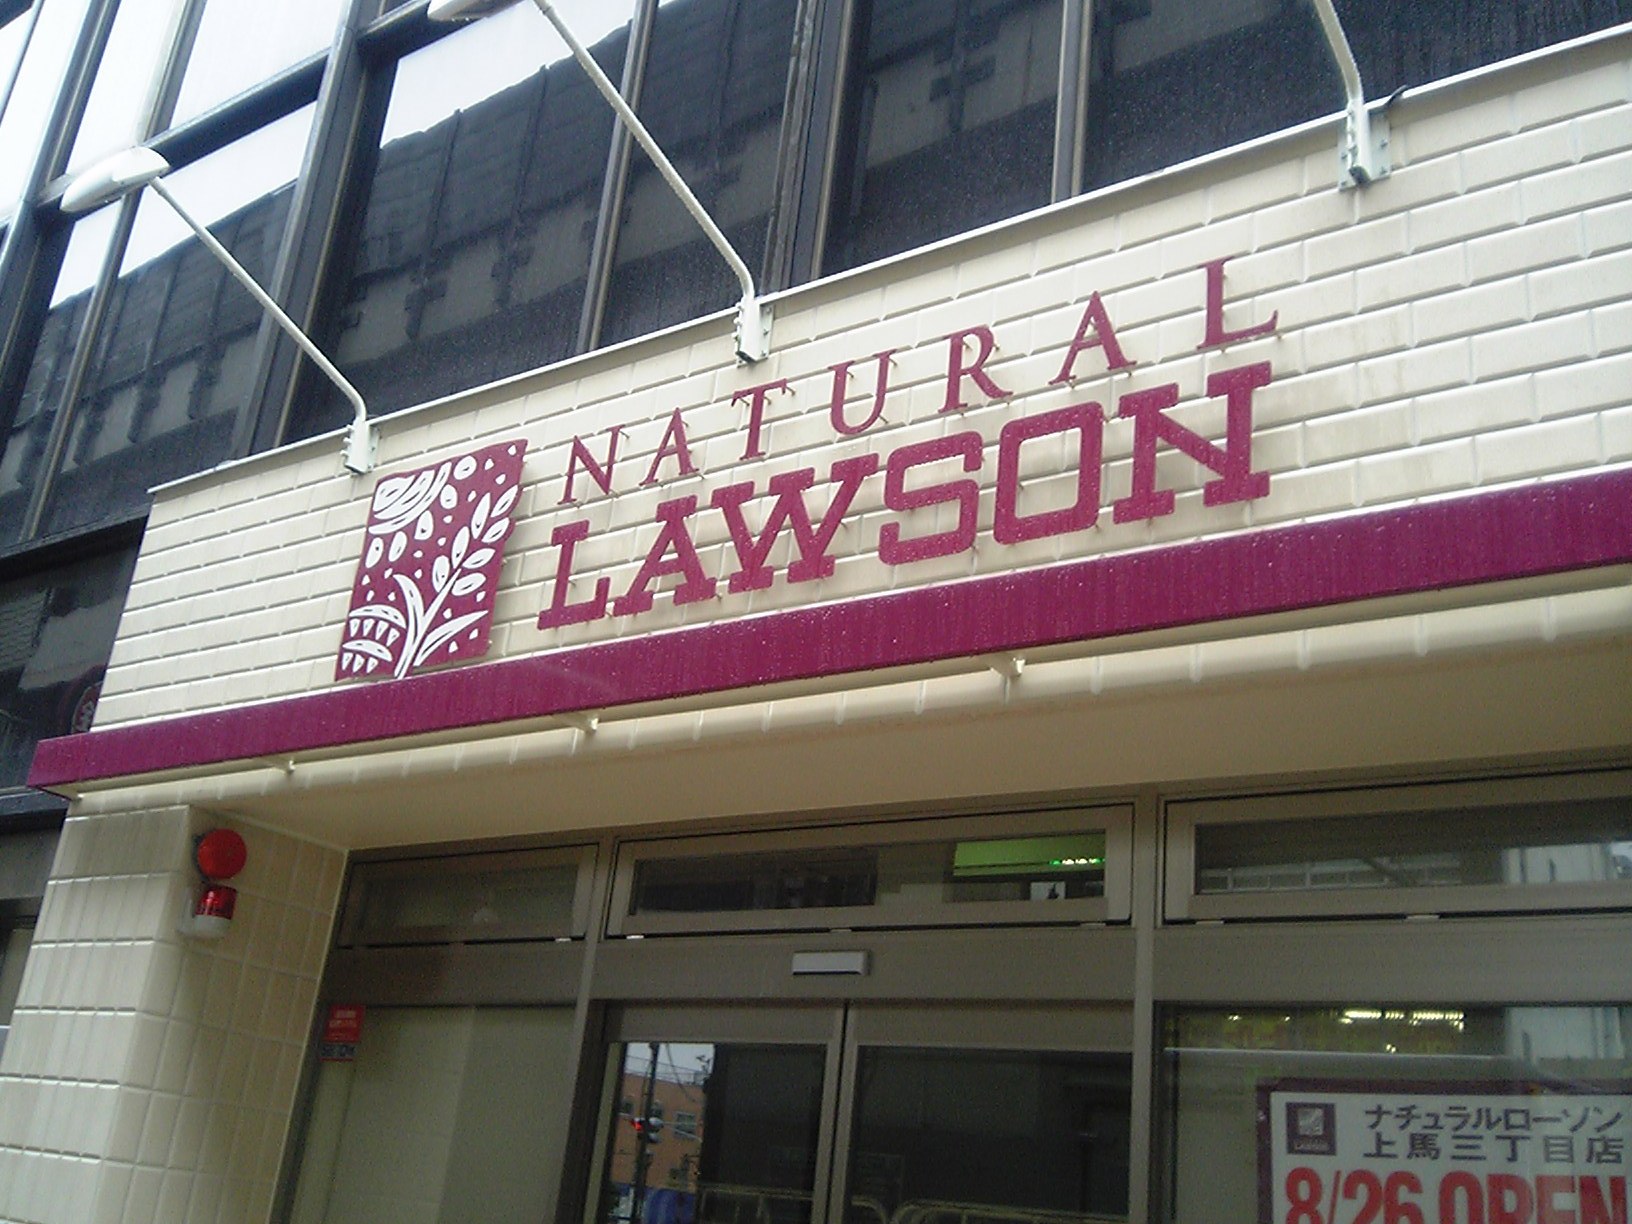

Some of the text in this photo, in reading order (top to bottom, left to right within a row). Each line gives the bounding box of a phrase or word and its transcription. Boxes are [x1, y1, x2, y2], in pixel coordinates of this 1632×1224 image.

[558, 257, 1278, 505] NATURAL
[538, 361, 1271, 629] LAWSON
[1364, 1105, 1623, 1132] ナチュラルローソン
[1363, 1133, 1624, 1163] 上馬三丁目店
[1286, 1167, 1627, 1224] 8/26 OPEN
